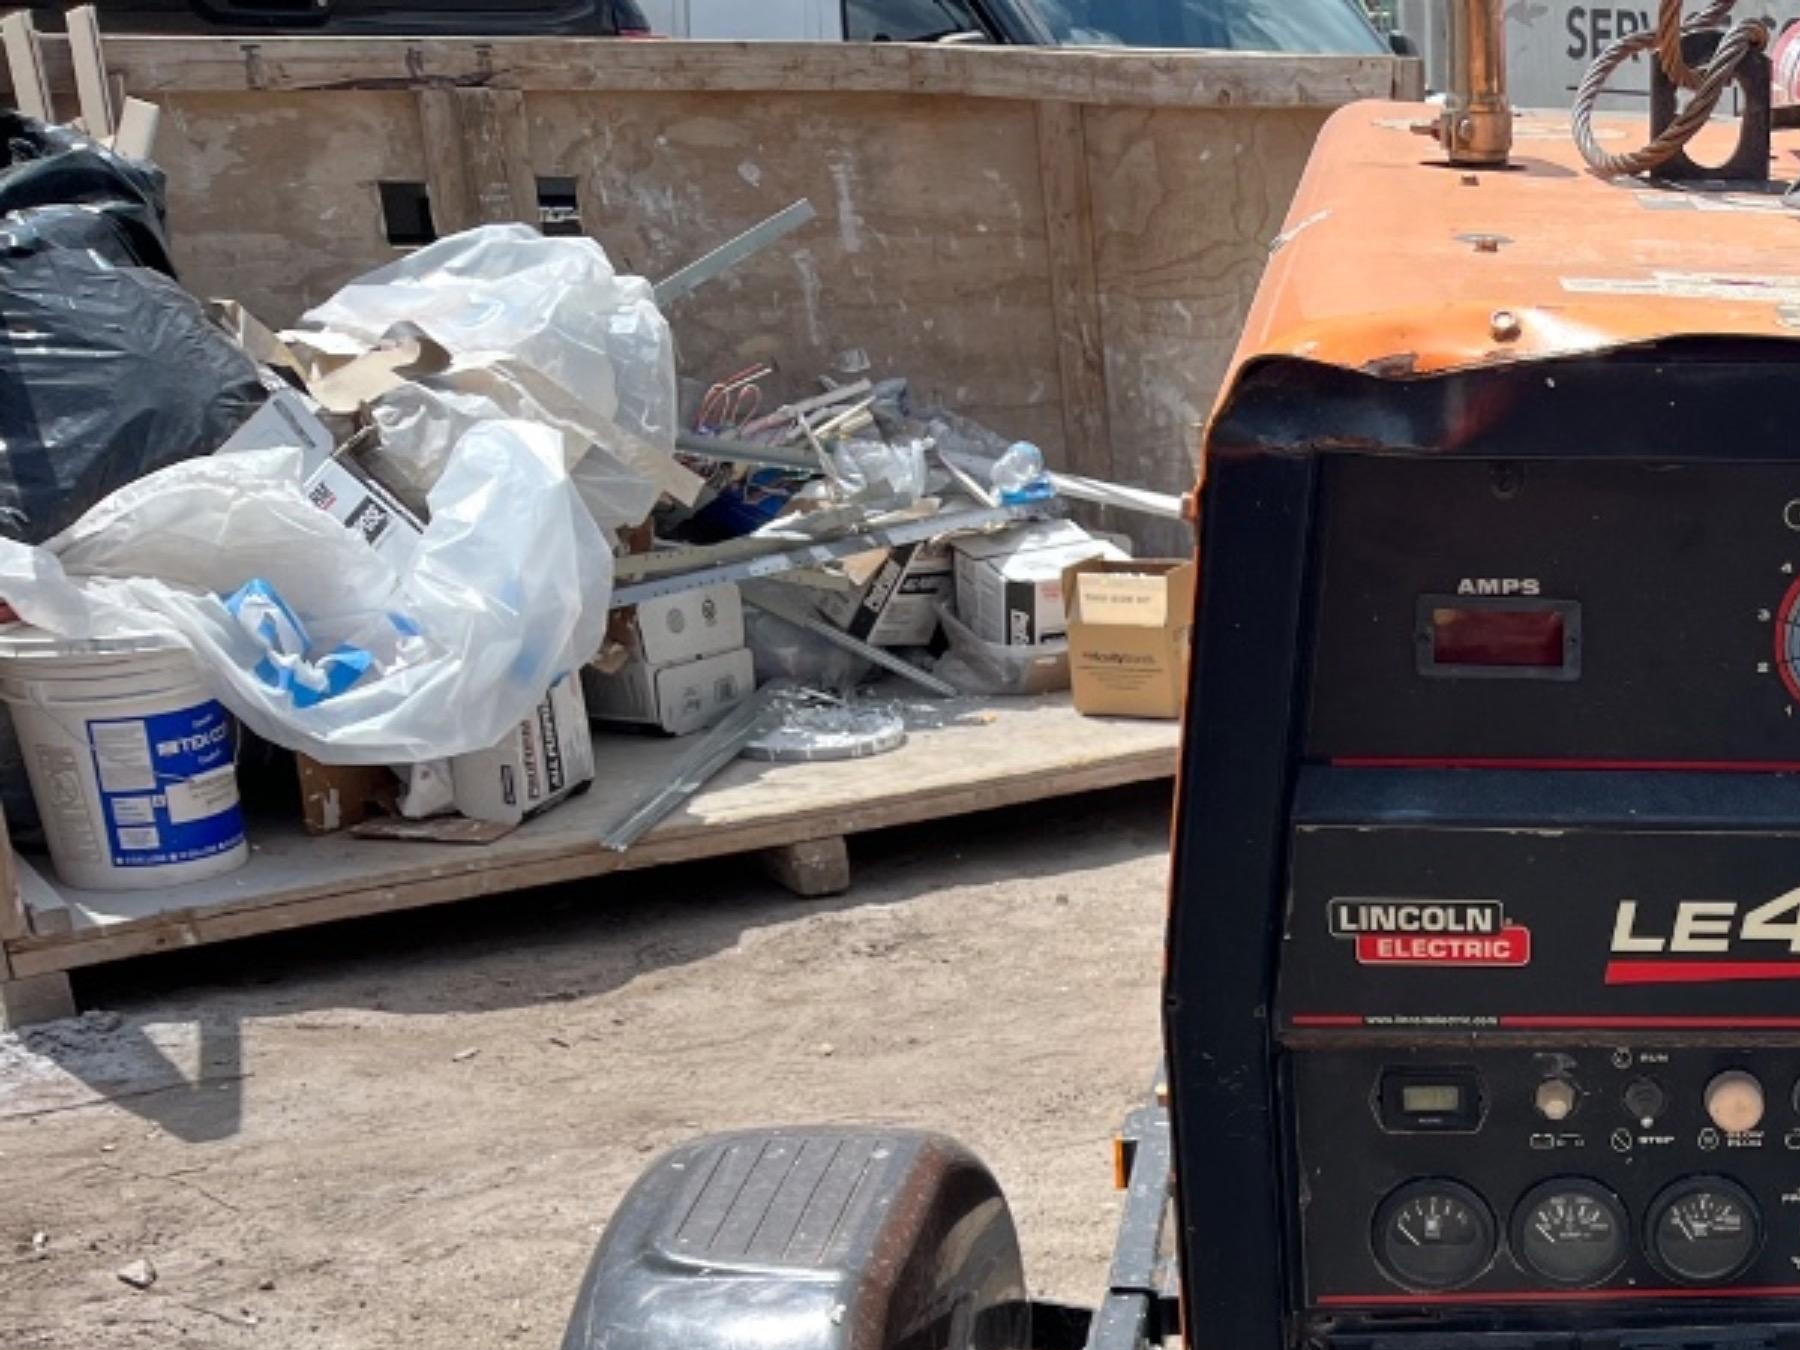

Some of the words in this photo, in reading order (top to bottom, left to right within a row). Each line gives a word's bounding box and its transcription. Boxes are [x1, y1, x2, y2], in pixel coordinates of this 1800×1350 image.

[1781, 563, 1792, 574] 4
[1457, 577, 1541, 596] AMPS
[1758, 608, 1770, 621] 3
[1784, 705, 1793, 717] 1
[1339, 905, 1493, 933] LINCOLN
[1376, 938, 1512, 959] ELECTRIC
